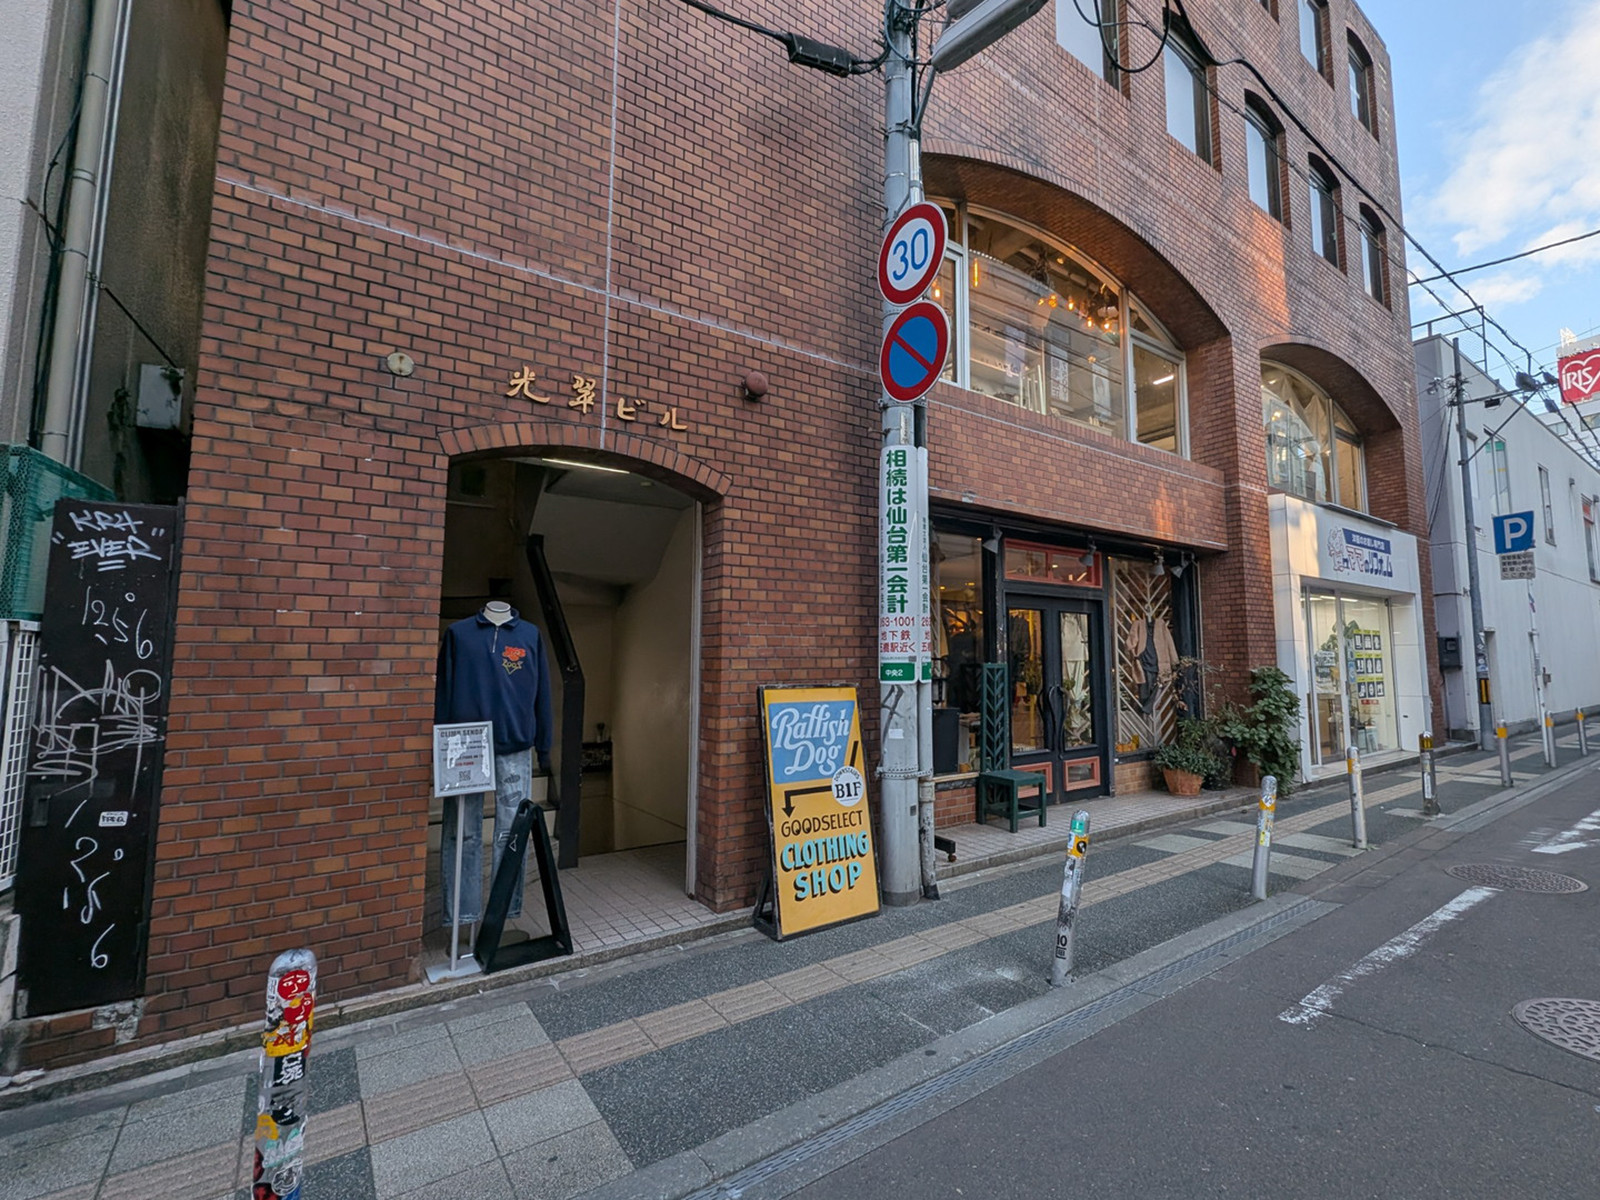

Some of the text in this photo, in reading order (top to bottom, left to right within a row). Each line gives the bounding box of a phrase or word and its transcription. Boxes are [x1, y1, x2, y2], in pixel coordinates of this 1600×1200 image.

[893, 228, 928, 280] 30
[1562, 366, 1593, 391] IRIS
[505, 366, 688, 430] 光翠ビル
[886, 450, 909, 614] 相続は仙台第一会計
[1503, 517, 1528, 549] P
[885, 669, 903, 677] 中央2
[784, 740, 841, 776] Dog
[835, 781, 861, 798] B1F
[780, 830, 869, 872] CLOTHING
[793, 861, 862, 901] SHOP
